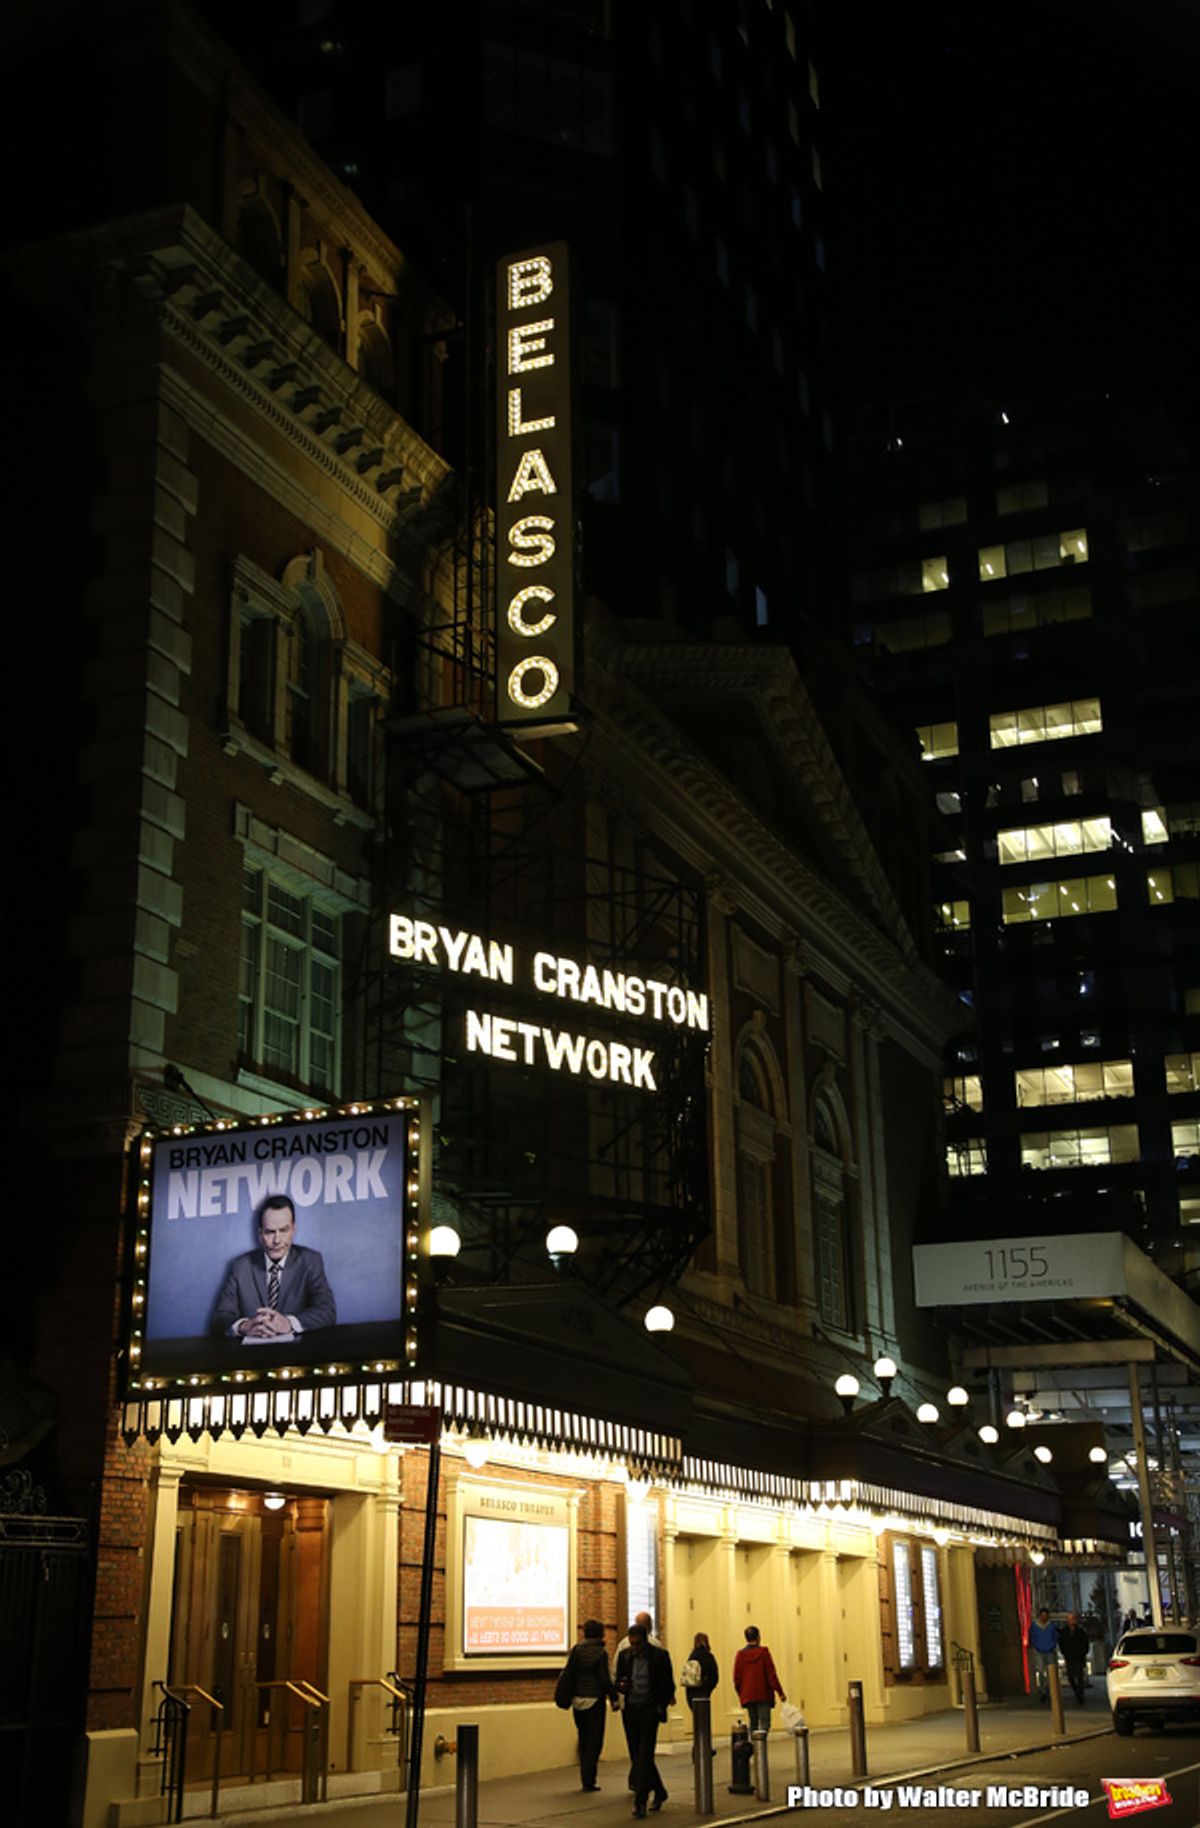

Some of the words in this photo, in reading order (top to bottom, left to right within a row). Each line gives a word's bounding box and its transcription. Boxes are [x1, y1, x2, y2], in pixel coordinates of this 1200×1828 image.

[507, 255, 559, 710] BELASCO
[389, 913, 514, 985] BRYAN
[533, 951, 709, 1031] CRANSTON
[465, 1010, 658, 1091] NETWORK
[169, 1141, 247, 1169] BRYAN
[253, 1125, 390, 1160] CRANSTON
[167, 1149, 389, 1220] NETWORK
[962, 1283, 996, 1292] AVENUE
[998, 1281, 1009, 1290] OF
[1011, 1280, 1028, 1289] THE
[984, 1246, 1049, 1279] 1155
